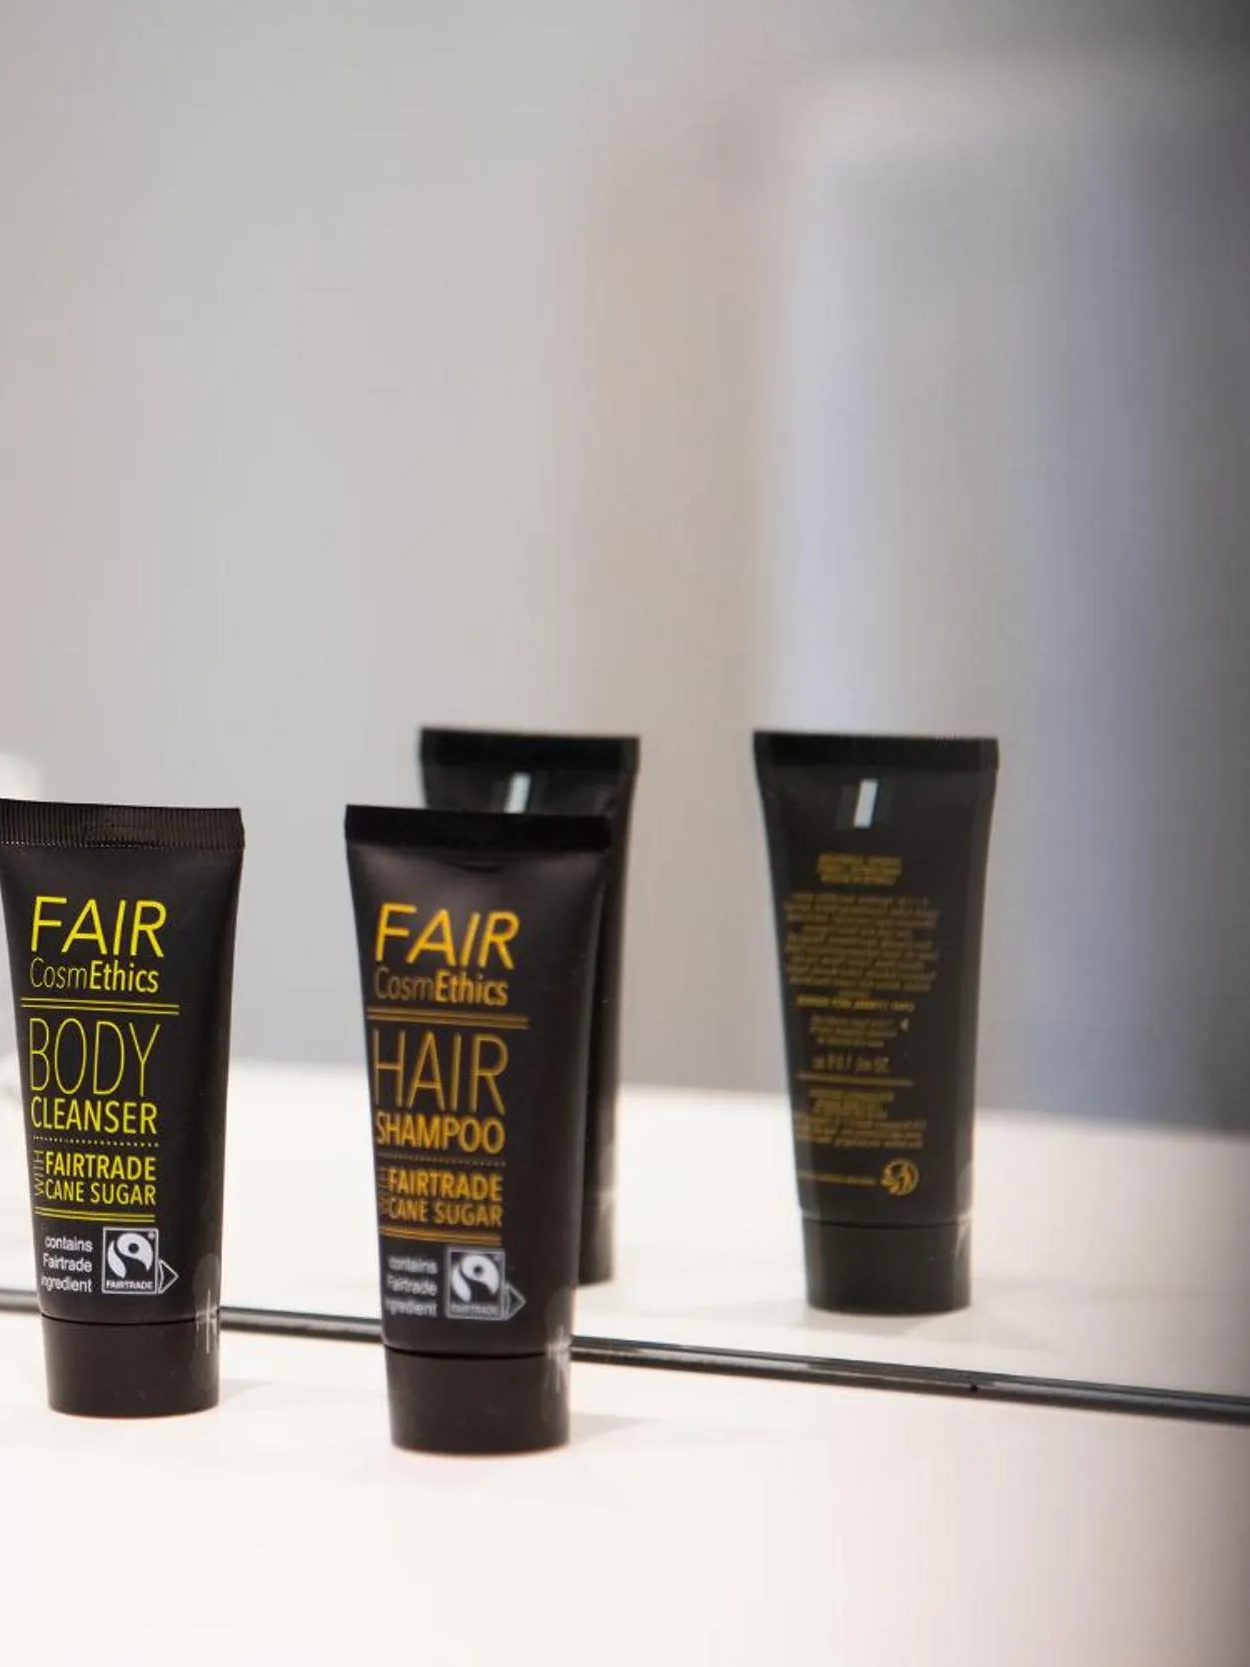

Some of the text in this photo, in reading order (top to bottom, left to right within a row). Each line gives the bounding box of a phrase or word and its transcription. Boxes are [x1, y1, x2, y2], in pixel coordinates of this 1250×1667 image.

[31, 896, 168, 958] FAIR
[375, 902, 520, 970] FAIR
[30, 956, 160, 993] CosmEthics
[374, 965, 508, 1006] CosmEthics
[29, 1017, 161, 1097] BODY
[372, 1029, 508, 1115] HAIR
[31, 1096, 158, 1135] CLEANSER
[376, 1110, 506, 1154] SHAMPOO
[45, 1151, 157, 1181] FAIRTRADE
[389, 1167, 503, 1201] FAIRTRADE
[45, 1178, 157, 1206] CANE SUGAR
[389, 1198, 503, 1228] CANE SUGAR
[44, 1235, 93, 1252] contains
[43, 1252, 93, 1273] Fairtrade
[105, 1279, 154, 1291] FAIRTRADE
